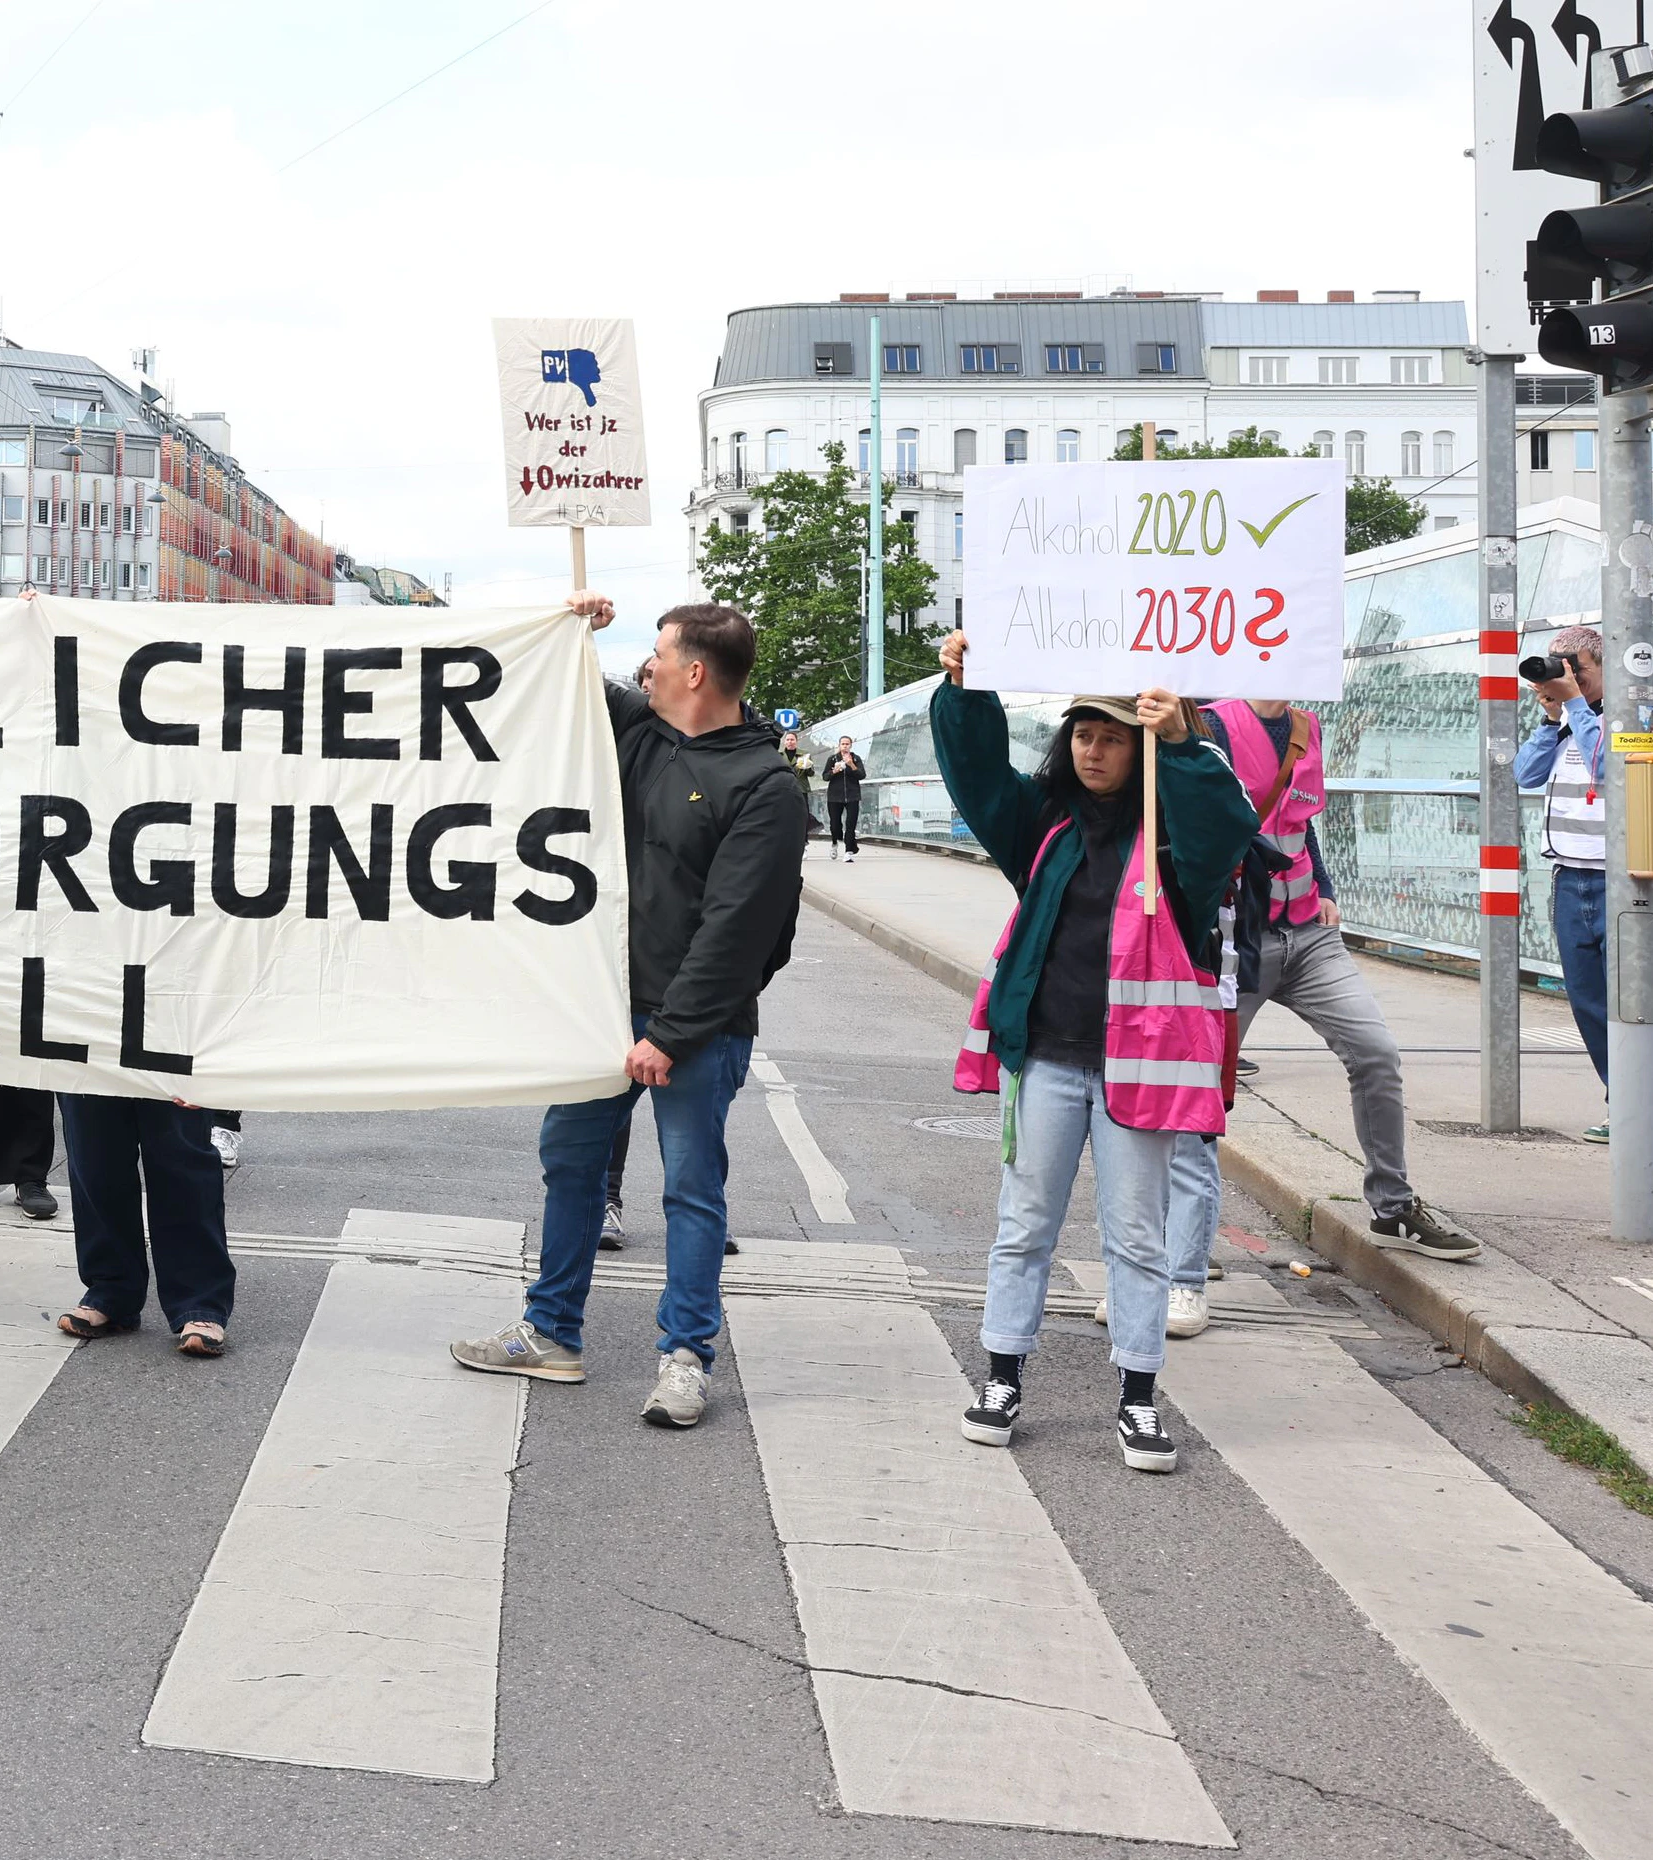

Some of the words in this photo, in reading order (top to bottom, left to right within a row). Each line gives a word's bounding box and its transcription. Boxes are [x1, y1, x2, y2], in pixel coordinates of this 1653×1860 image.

[1592, 326, 1614, 343] 13
[524, 411, 561, 432] Wer
[570, 413, 591, 431] ist
[600, 415, 617, 435] jz
[558, 440, 587, 457] der
[537, 464, 644, 491] Owizahrer
[576, 504, 605, 520] PVA
[1002, 494, 1121, 556] Alkohol
[1127, 488, 1227, 556] 2020
[1003, 585, 1124, 649] Alkohol
[780, 713, 794, 728] U
[1298, 791, 1319, 805] SHW
